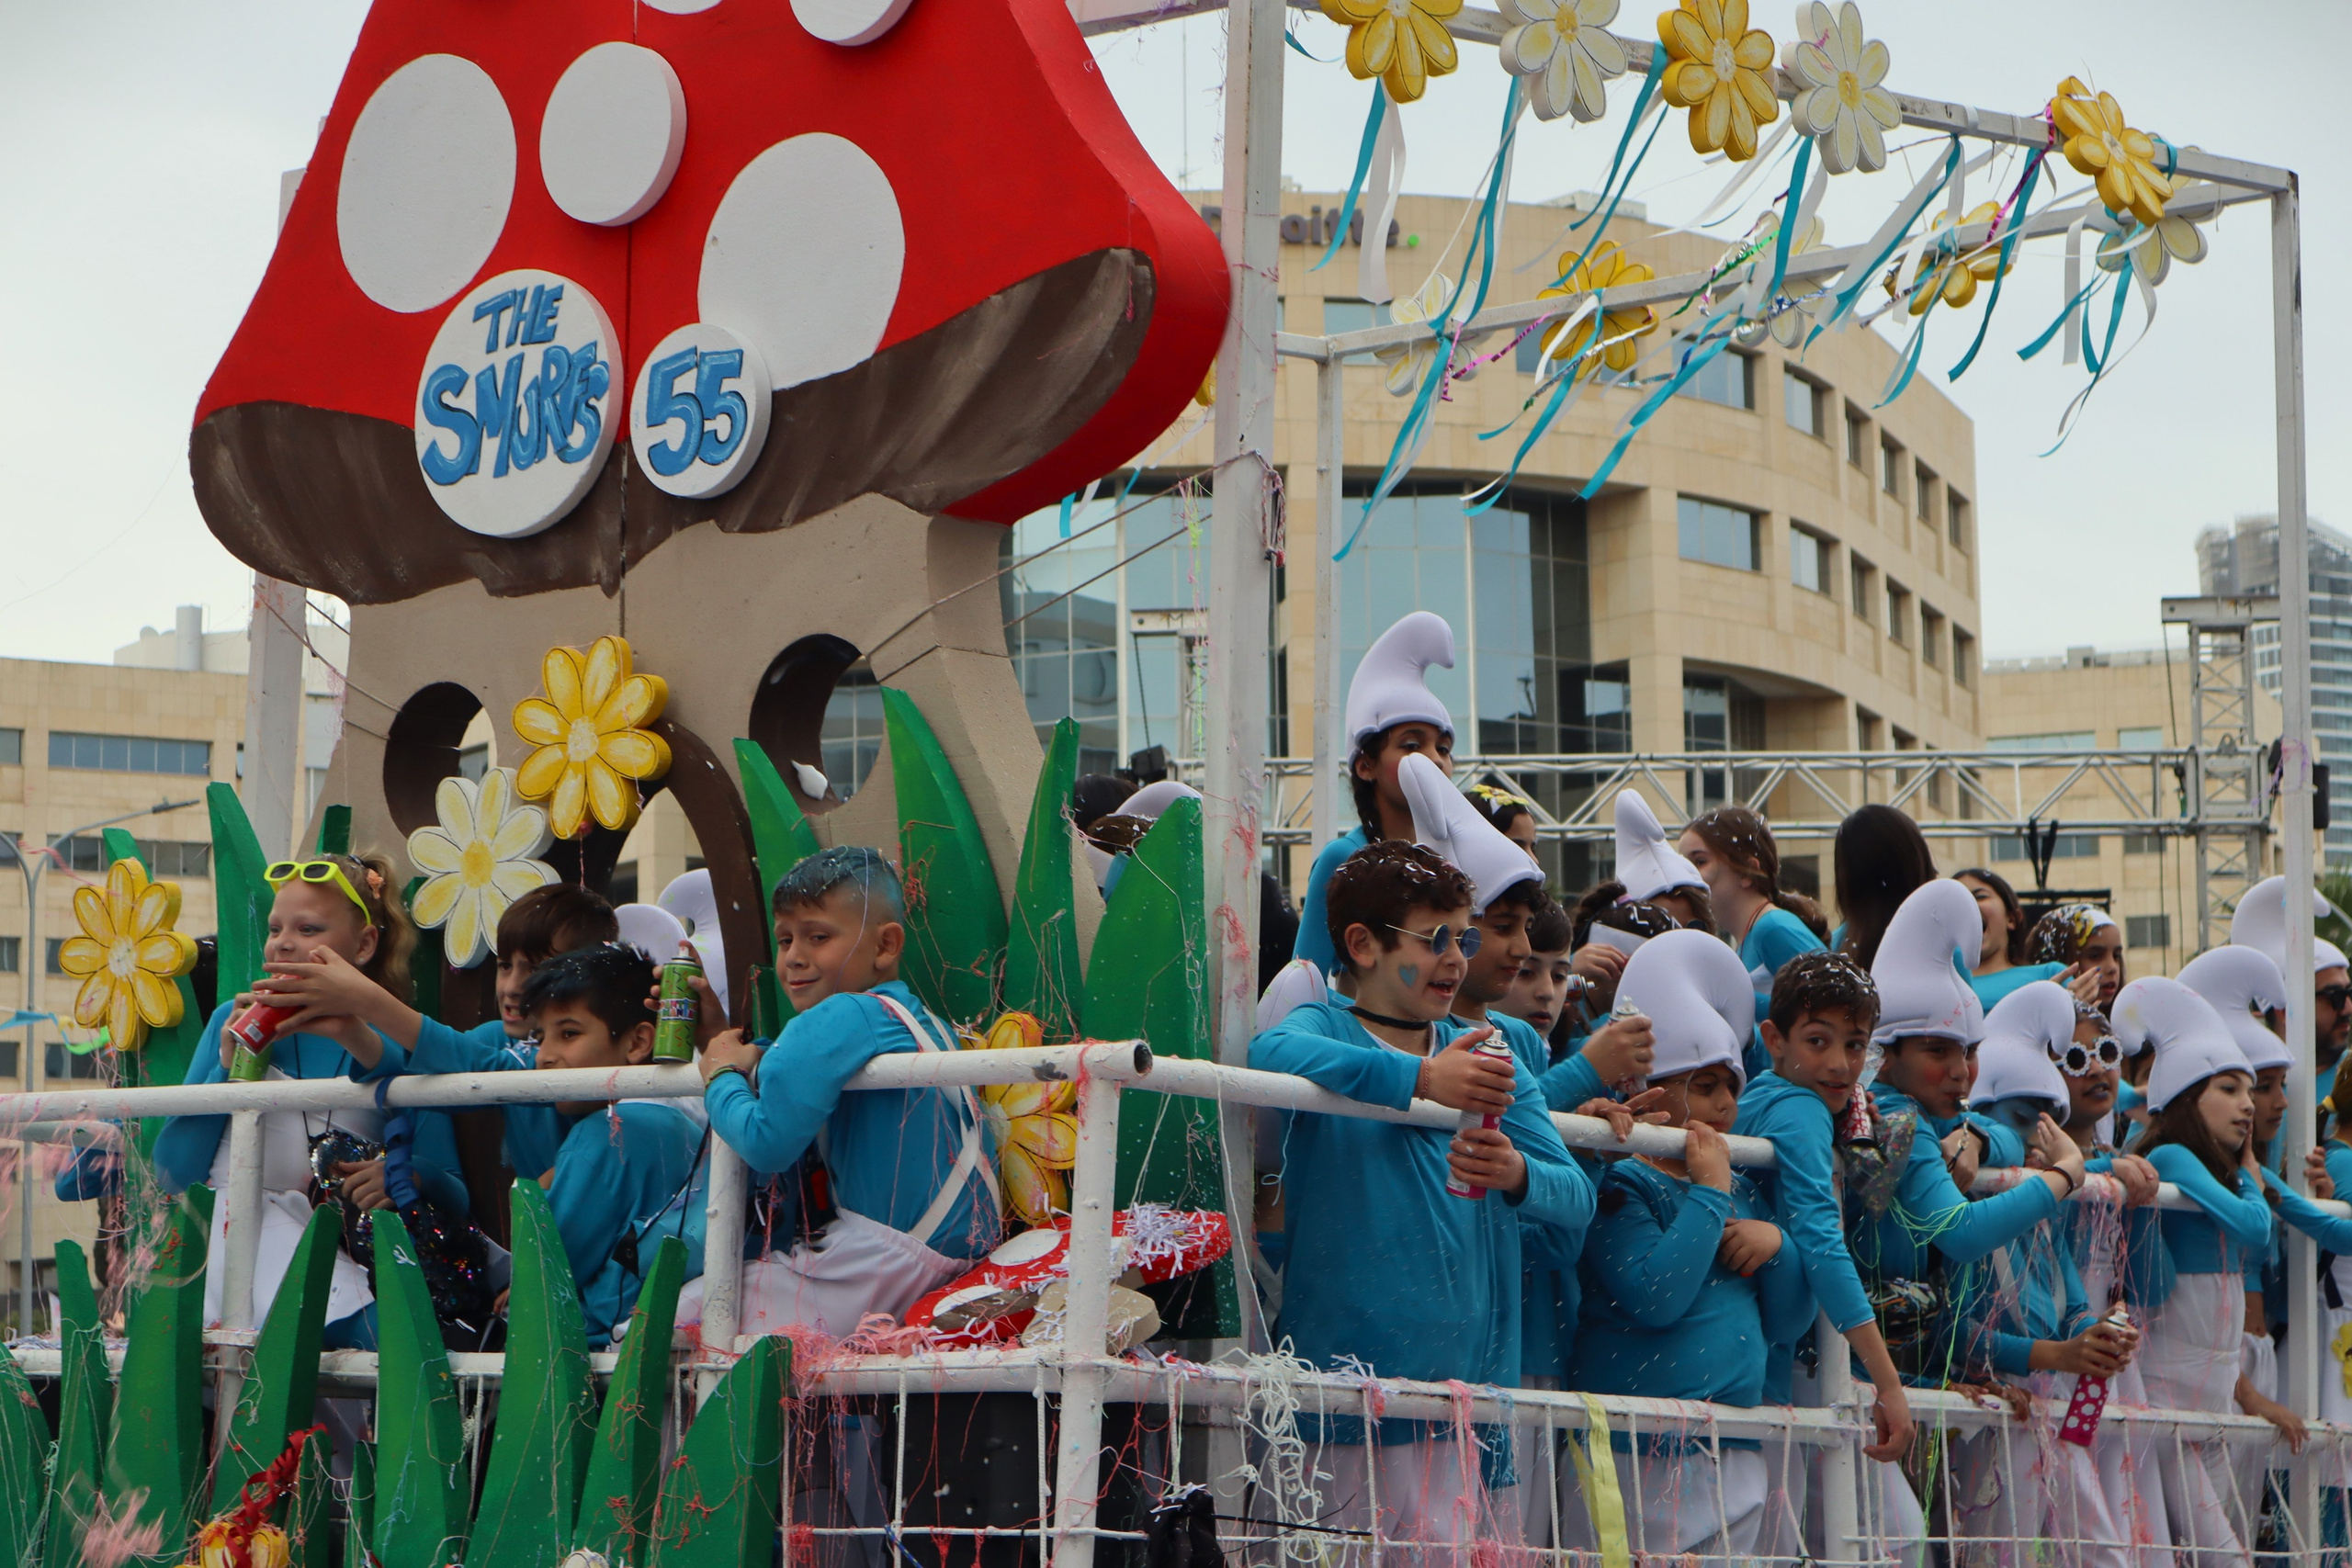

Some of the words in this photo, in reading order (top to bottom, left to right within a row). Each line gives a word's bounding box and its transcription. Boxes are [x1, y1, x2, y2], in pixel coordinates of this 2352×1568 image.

[472, 284, 564, 355] THE
[421, 341, 610, 486] SMURFS
[647, 345, 748, 477] 55
